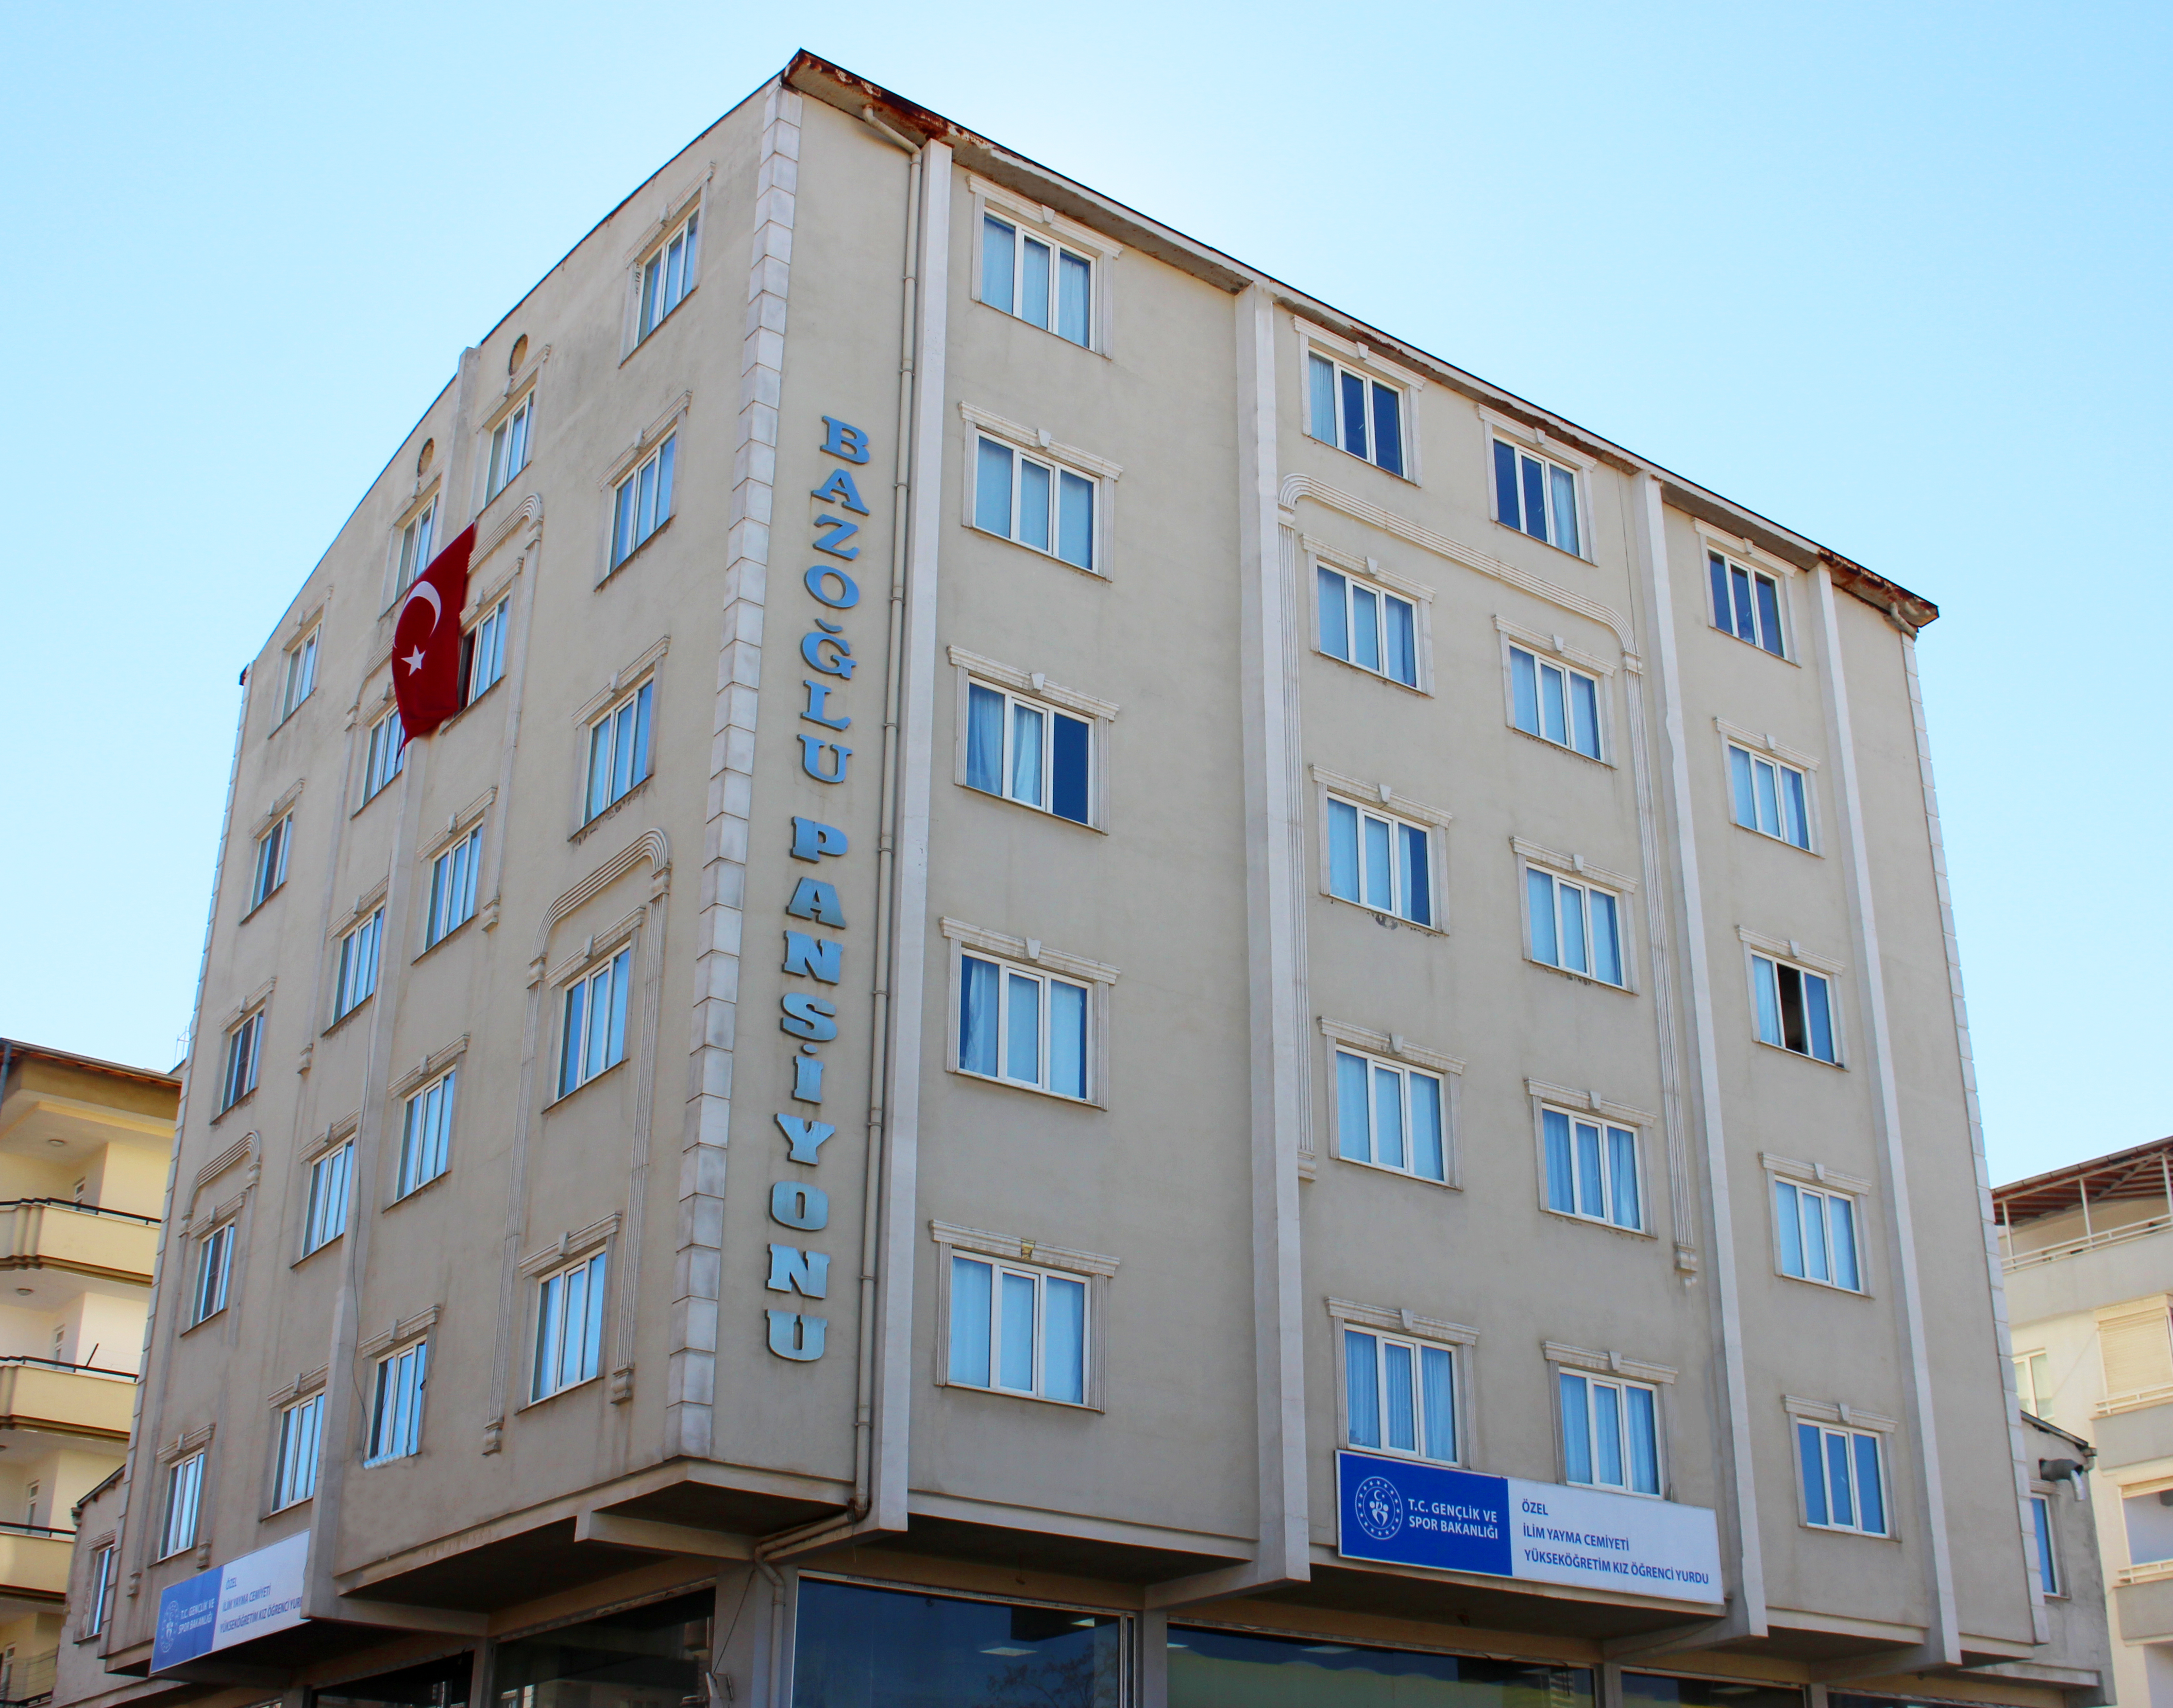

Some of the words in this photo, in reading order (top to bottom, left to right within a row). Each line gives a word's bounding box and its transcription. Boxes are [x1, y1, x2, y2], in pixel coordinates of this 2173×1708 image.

[797, 415, 870, 784] BAZOĞLU
[765, 816, 849, 1362] PANSİYONU
[1408, 1498, 1428, 1512] T.C.
[1431, 1502, 1480, 1520] GENÇLİK
[1483, 1510, 1497, 1523] VE
[1522, 1498, 1548, 1515] ÖZEL
[1409, 1516, 1438, 1530] SPOR
[1441, 1523, 1498, 1539] BAKANLIĞI
[1523, 1523, 1545, 1539] İLİM
[1547, 1528, 1581, 1545] YAYMA
[1584, 1534, 1629, 1551] CEMİYETİ
[1525, 1548, 1611, 1572] YÜKSEKÖĞRETİM
[1613, 1561, 1629, 1575] KIZ
[1631, 1562, 1674, 1580] ÖĞRENCİ
[1675, 1569, 1709, 1584] YURDU
[226, 1577, 237, 1590] ÖZEL
[208, 1598, 215, 1609] VE
[259, 1608, 267, 1620] KIZ
